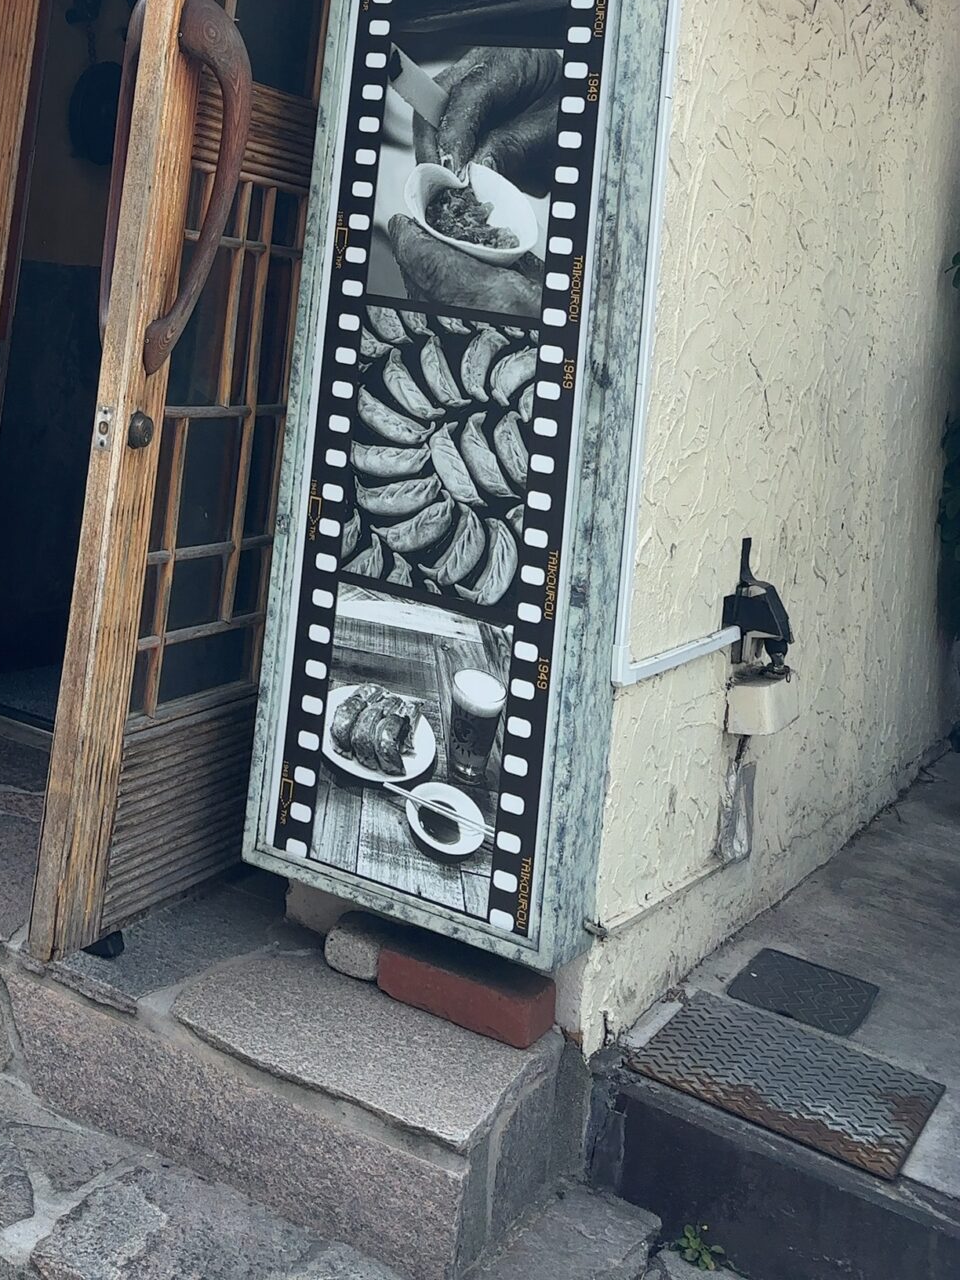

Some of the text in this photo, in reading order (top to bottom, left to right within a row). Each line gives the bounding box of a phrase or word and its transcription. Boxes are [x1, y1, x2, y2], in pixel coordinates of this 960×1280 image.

[587, 72, 600, 103] 1949
[569, 254, 583, 323] TAIKOUROU
[562, 357, 575, 389] 1949
[543, 549, 559, 621] TAIKOUROU
[536, 656, 550, 690] 1949
[515, 856, 532, 930] TAIKOUROU
